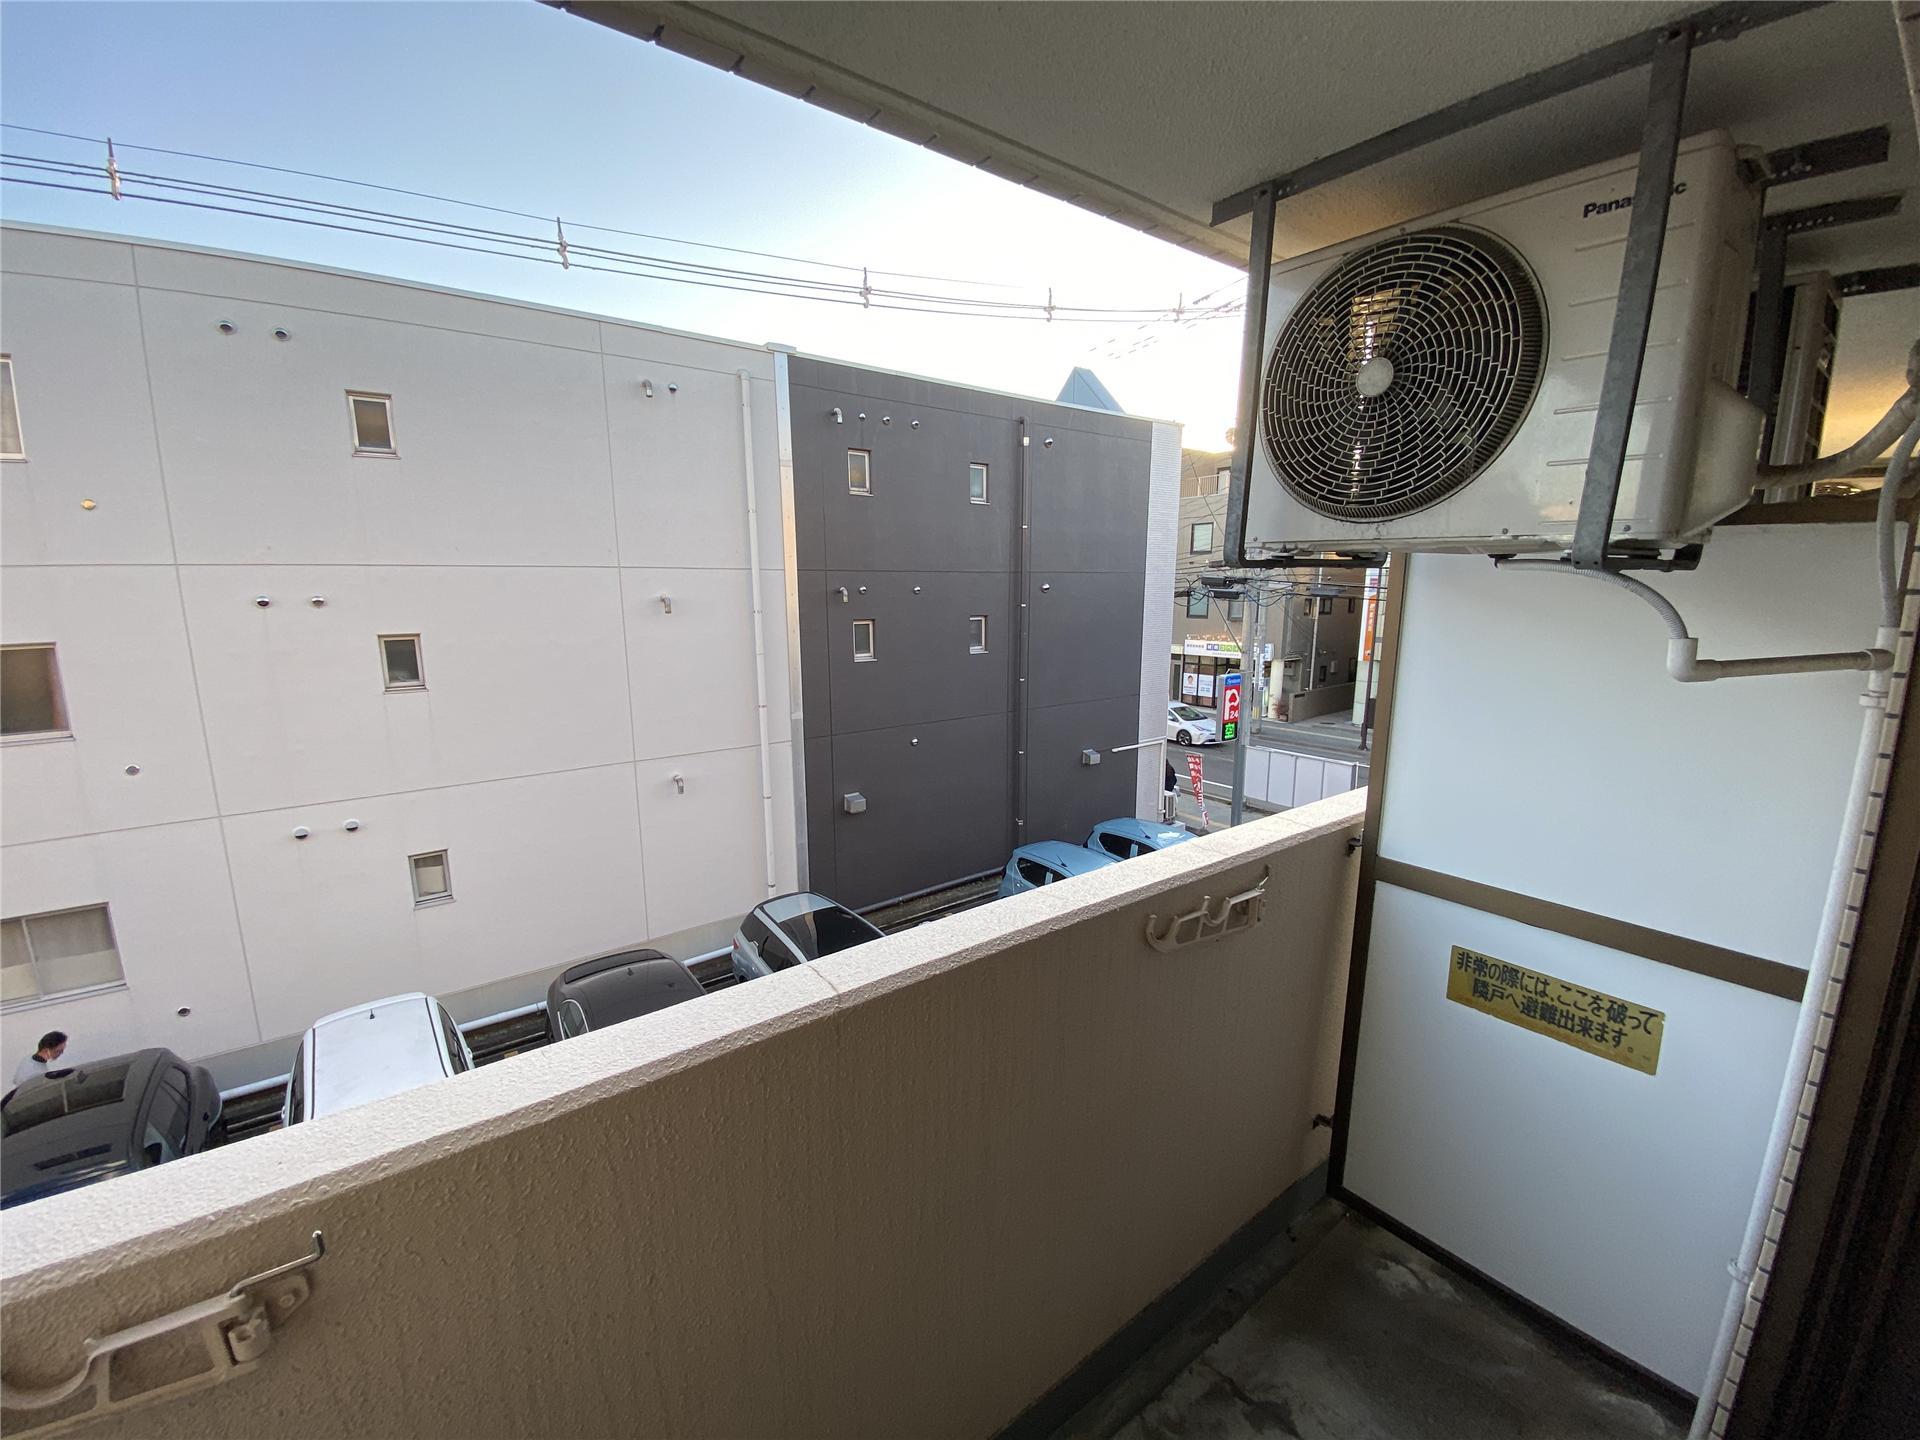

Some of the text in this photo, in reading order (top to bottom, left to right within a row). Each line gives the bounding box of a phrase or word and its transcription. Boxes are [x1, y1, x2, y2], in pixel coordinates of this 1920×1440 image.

[1583, 182, 1687, 219] Panac
[1229, 710, 1239, 719] 24
[1456, 951, 1659, 1035] 非常の際には、ここを破って
[1471, 977, 1634, 1054] 隣戸へ避難出来ます。
